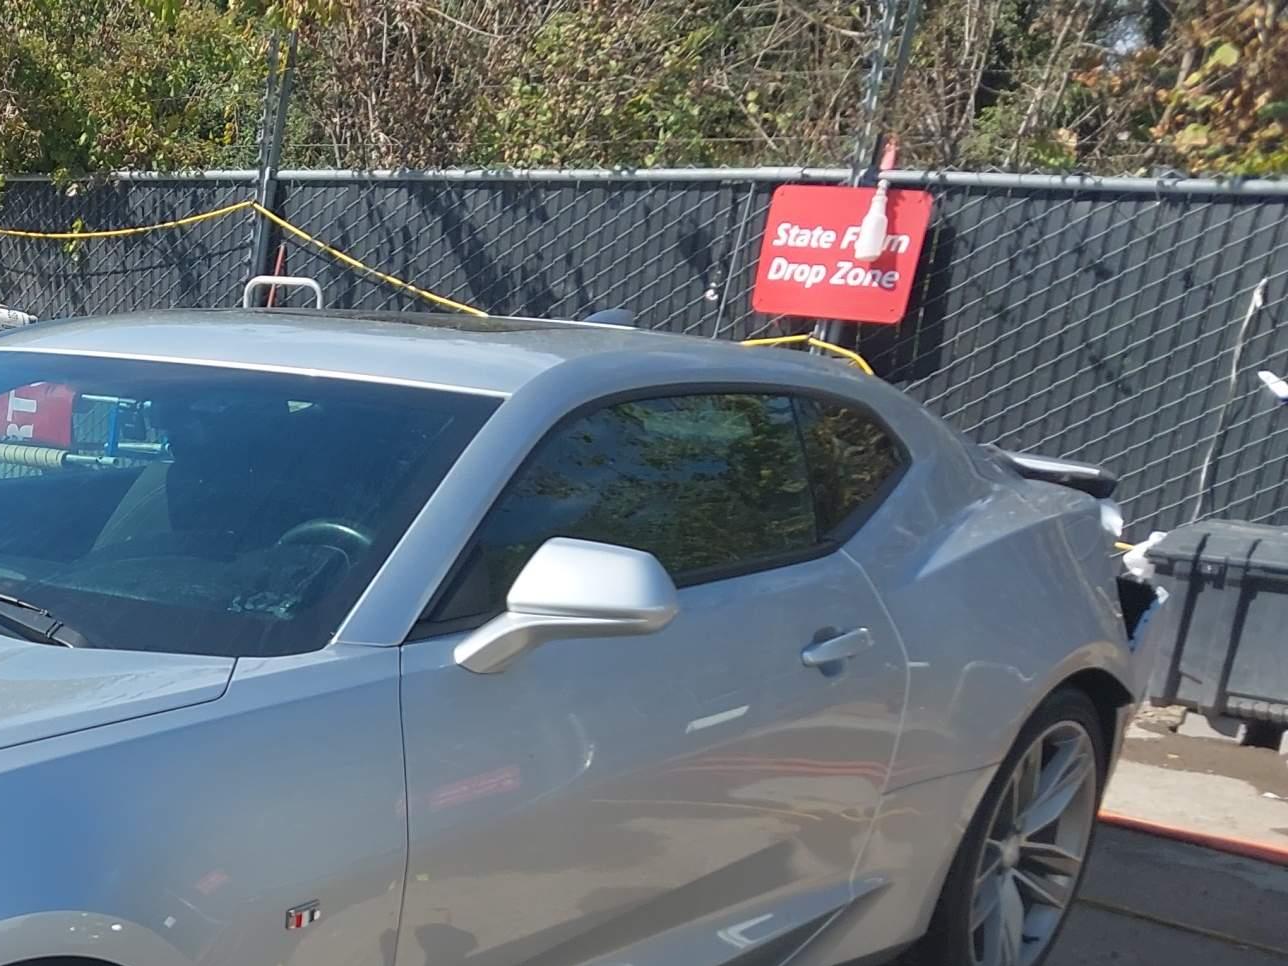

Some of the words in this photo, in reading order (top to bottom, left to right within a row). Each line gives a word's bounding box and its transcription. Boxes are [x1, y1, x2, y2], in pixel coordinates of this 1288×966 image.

[772, 223, 836, 249] State
[840, 226, 911, 253] Fm
[768, 257, 825, 288] Drop
[829, 261, 900, 289] Zone
